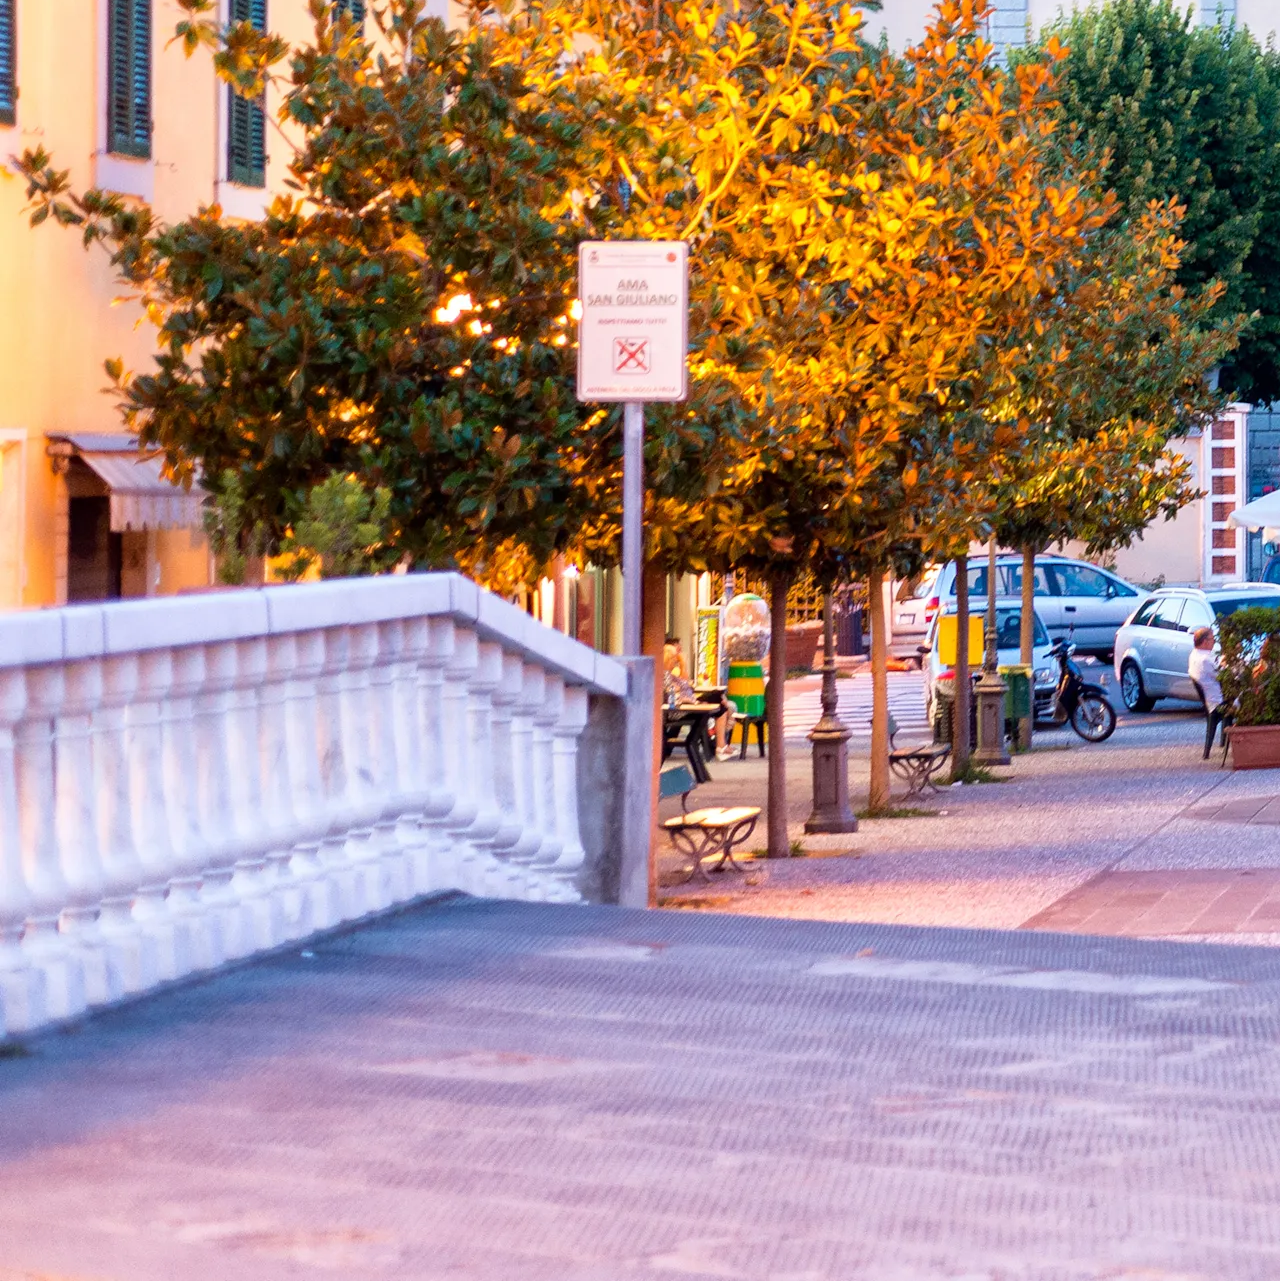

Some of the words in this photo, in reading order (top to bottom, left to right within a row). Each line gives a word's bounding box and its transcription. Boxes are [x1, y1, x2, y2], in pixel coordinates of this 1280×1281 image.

[617, 279, 649, 290] AMA
[587, 294, 612, 306] SAN
[616, 294, 678, 306] GIULIANO
